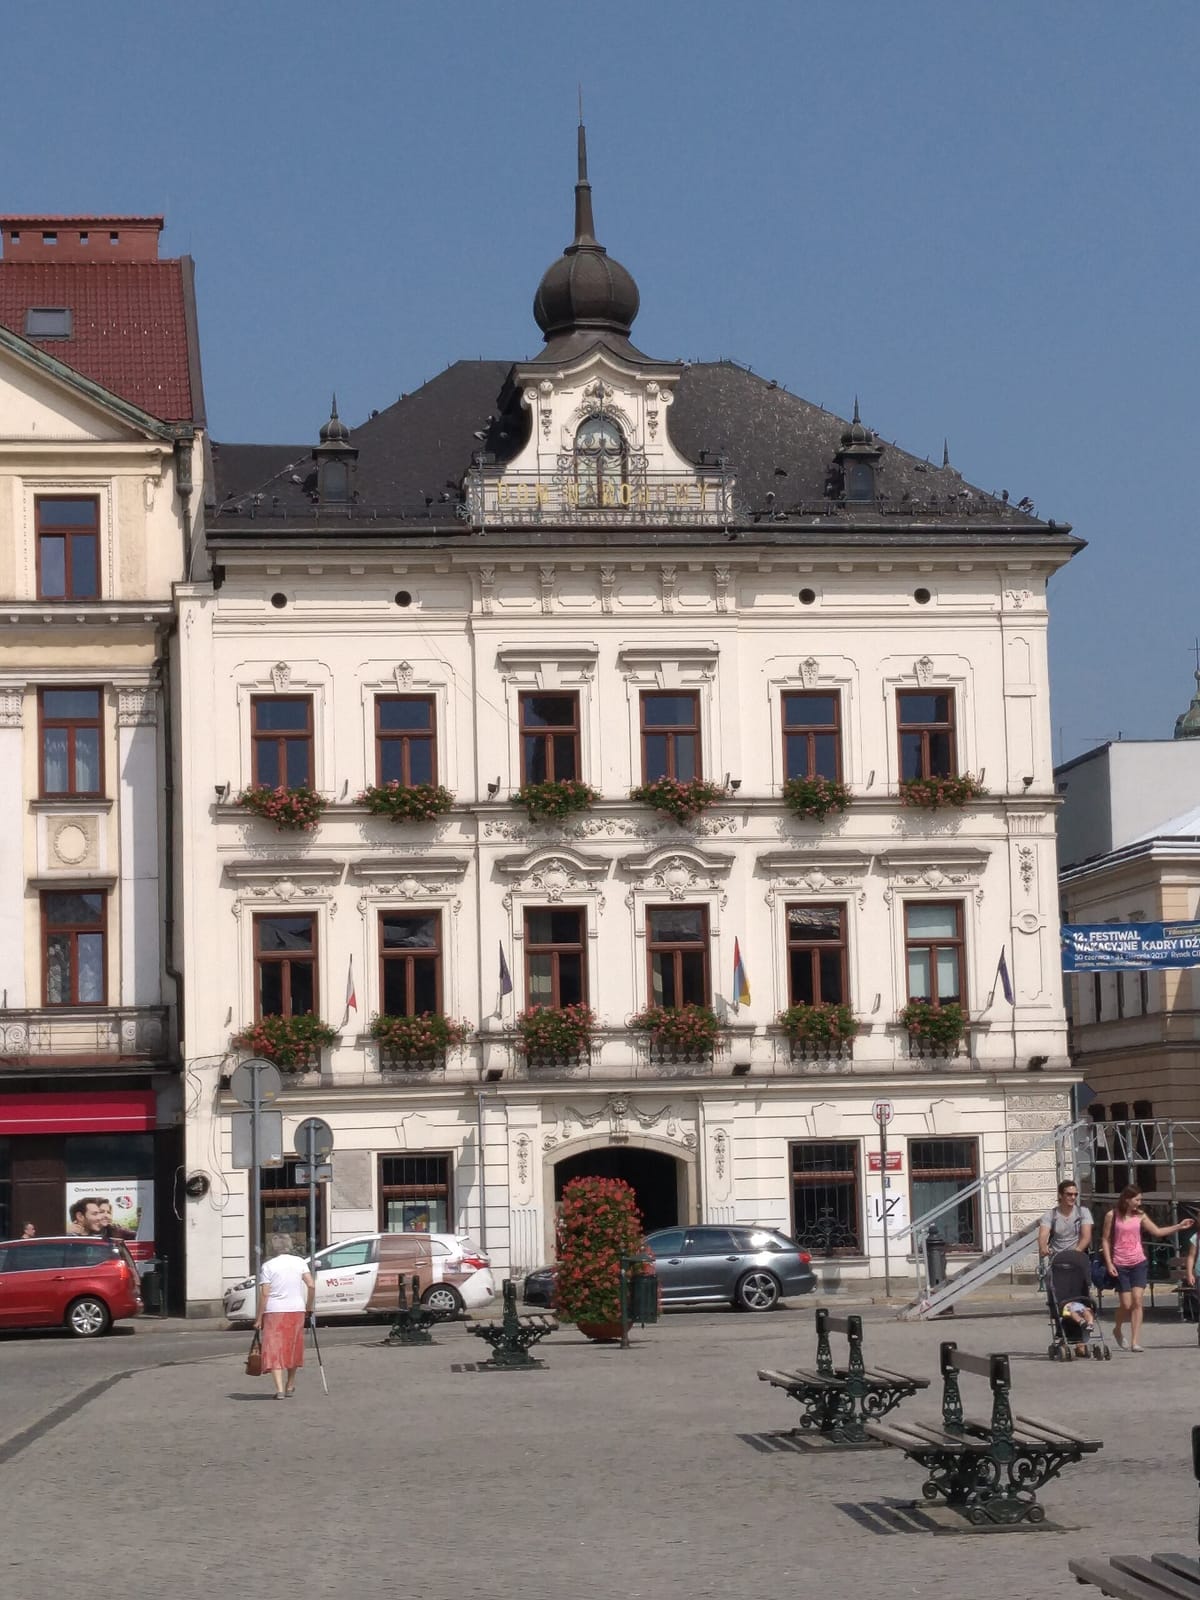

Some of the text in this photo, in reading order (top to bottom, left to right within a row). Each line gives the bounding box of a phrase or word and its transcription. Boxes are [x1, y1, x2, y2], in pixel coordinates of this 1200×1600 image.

[498, 482, 548, 504] DOM
[1073, 930, 1141, 941] 12. FESTIWAL
[1073, 935, 1200, 952] WAKACYJNE KADRY I DŹ
